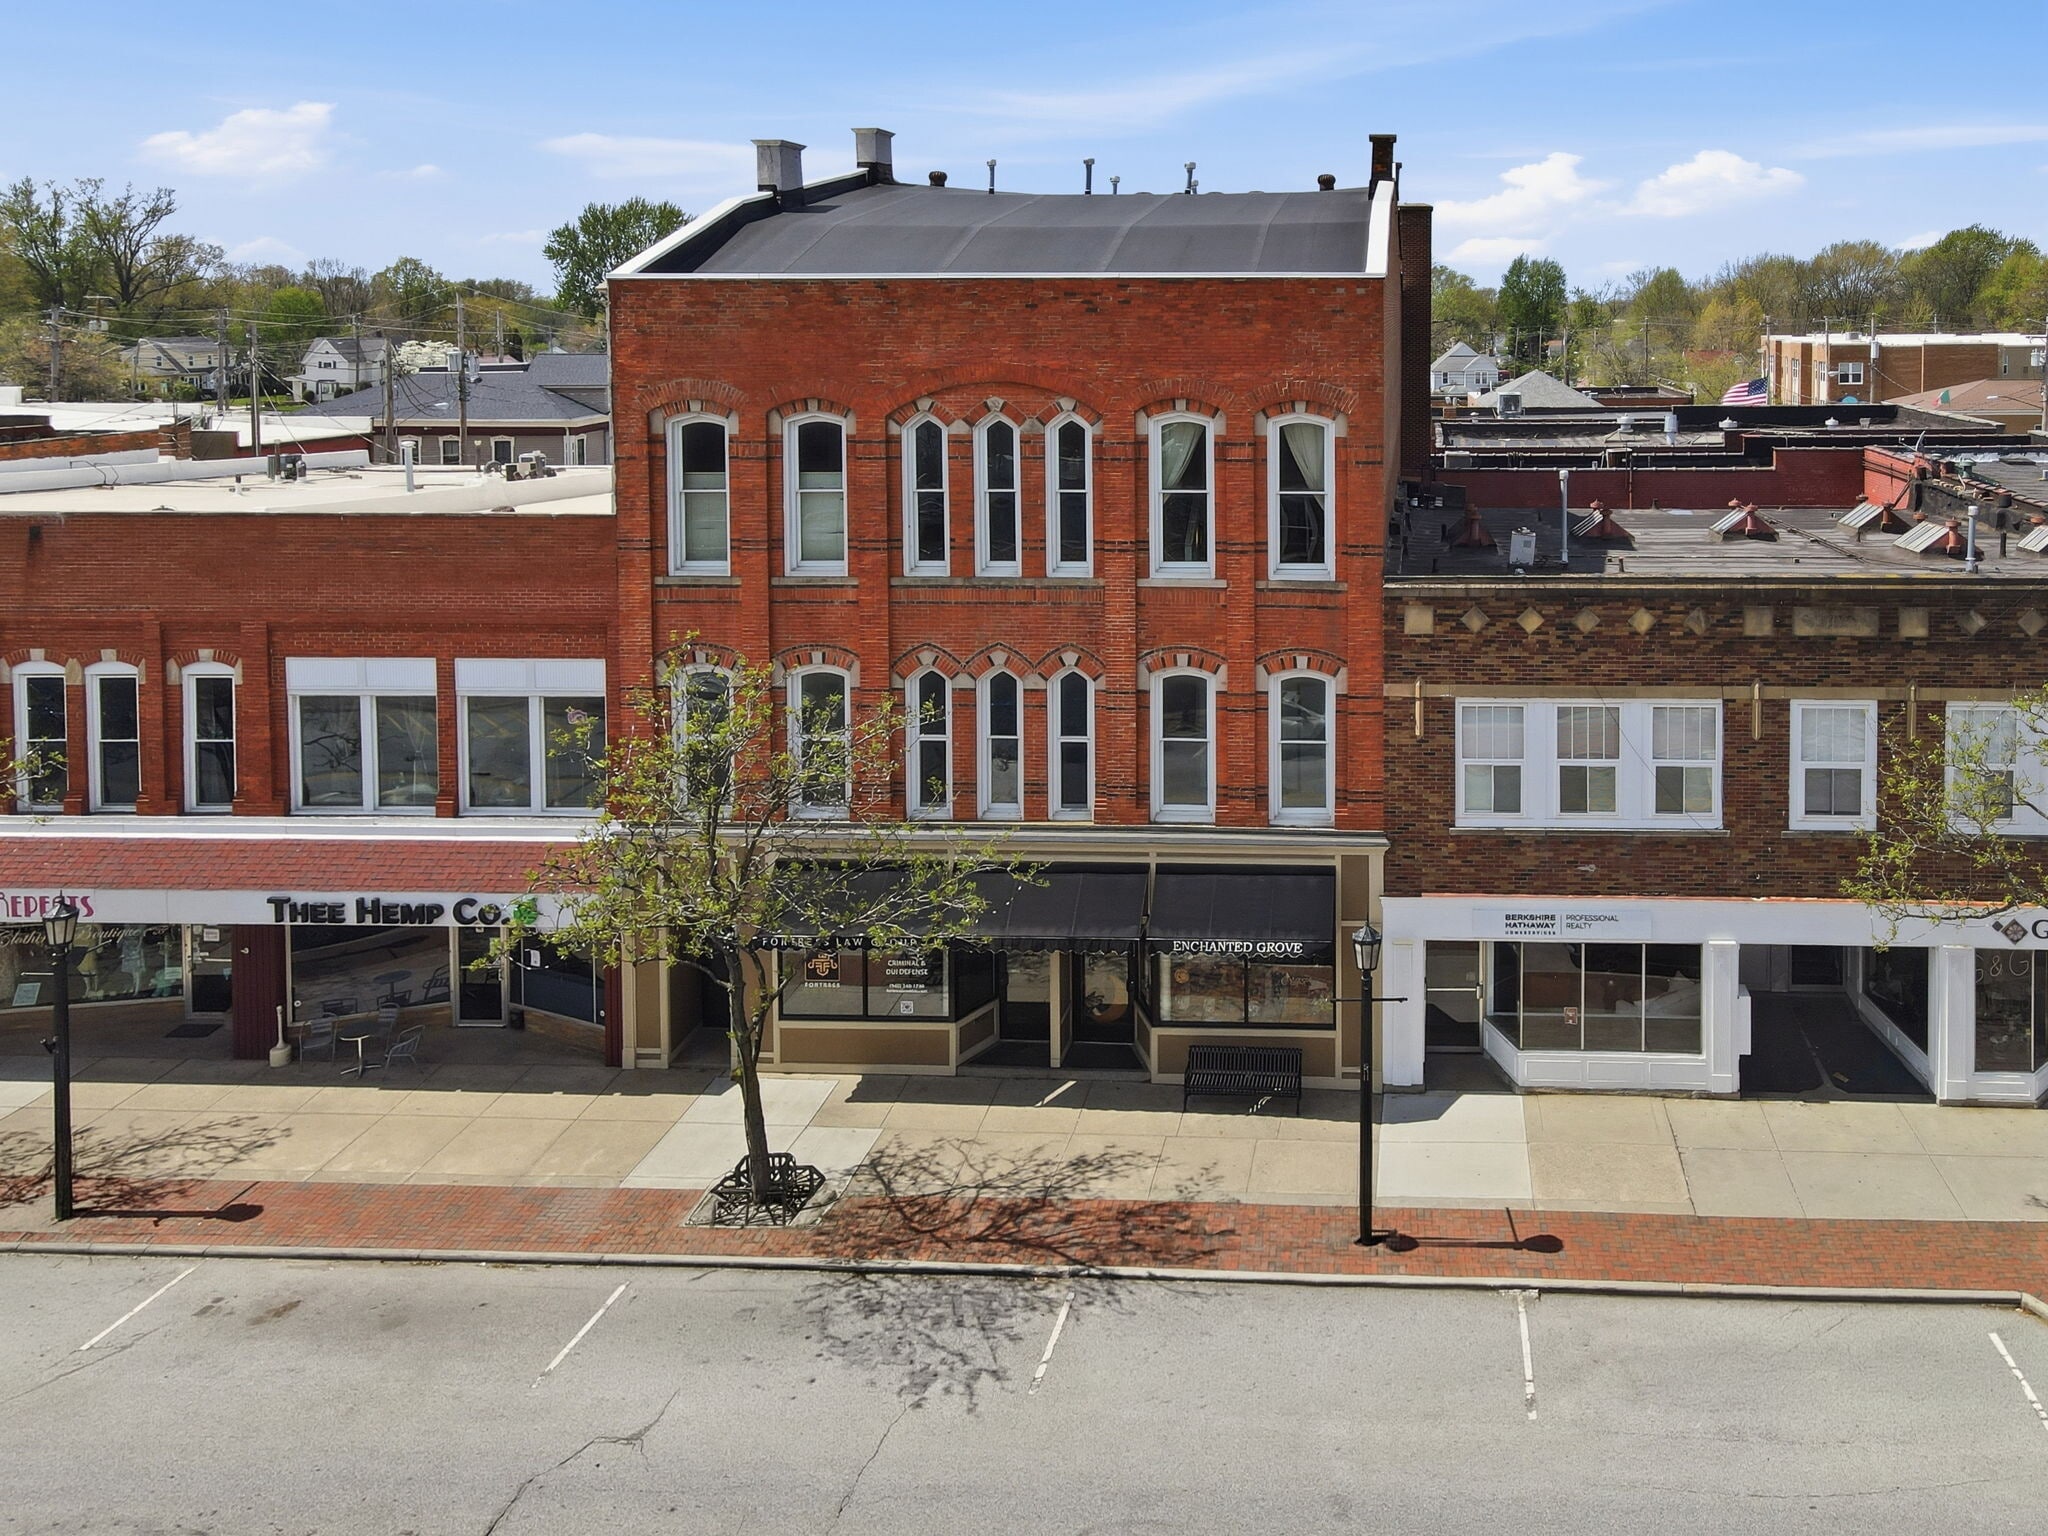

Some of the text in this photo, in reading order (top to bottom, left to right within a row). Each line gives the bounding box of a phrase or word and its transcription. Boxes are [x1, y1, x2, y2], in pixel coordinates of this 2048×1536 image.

[267, 896, 346, 924] THEE
[355, 896, 445, 925] HEMP
[1565, 914, 1619, 922] PROFESSIONAL
[762, 937, 830, 948] FORRES
[836, 938, 864, 948] LAW
[871, 938, 918, 948] GOUP
[1173, 940, 1304, 954] ENCHANTED GROVE
[887, 959, 920, 967] CRIMINAL
[899, 968, 929, 976] DEFENSE
